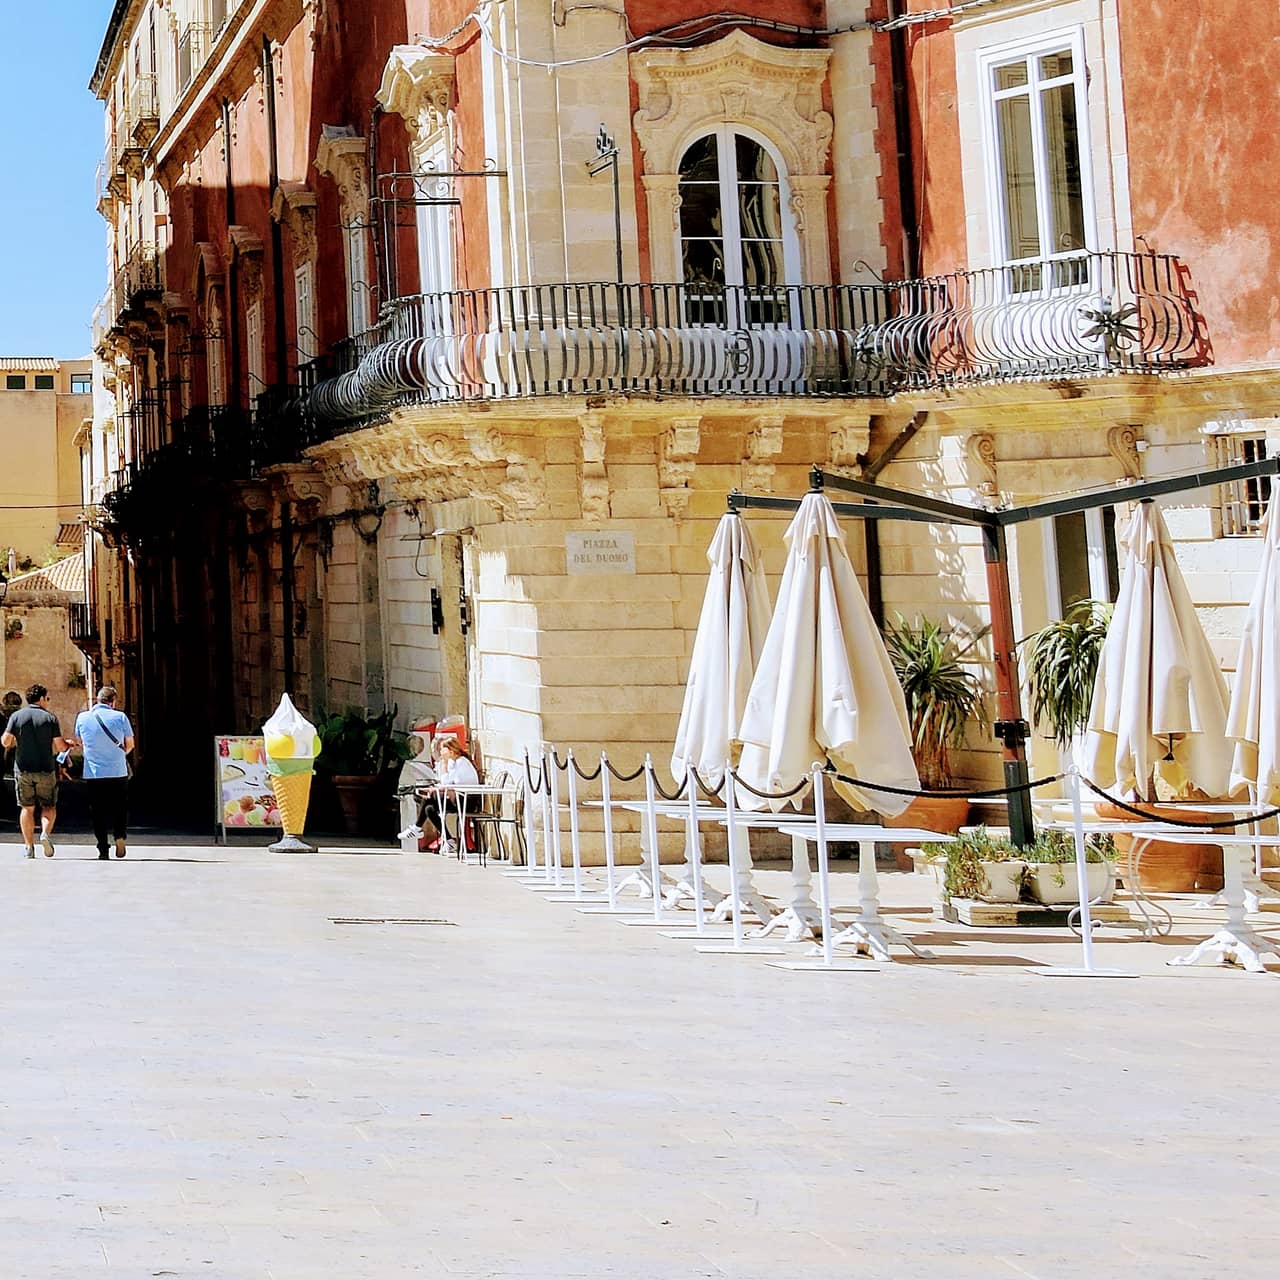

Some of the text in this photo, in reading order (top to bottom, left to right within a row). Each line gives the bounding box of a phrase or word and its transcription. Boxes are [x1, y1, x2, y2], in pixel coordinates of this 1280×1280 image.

[583, 539, 618, 549] PIAZZA
[574, 553, 629, 563] DEL DUOMO
